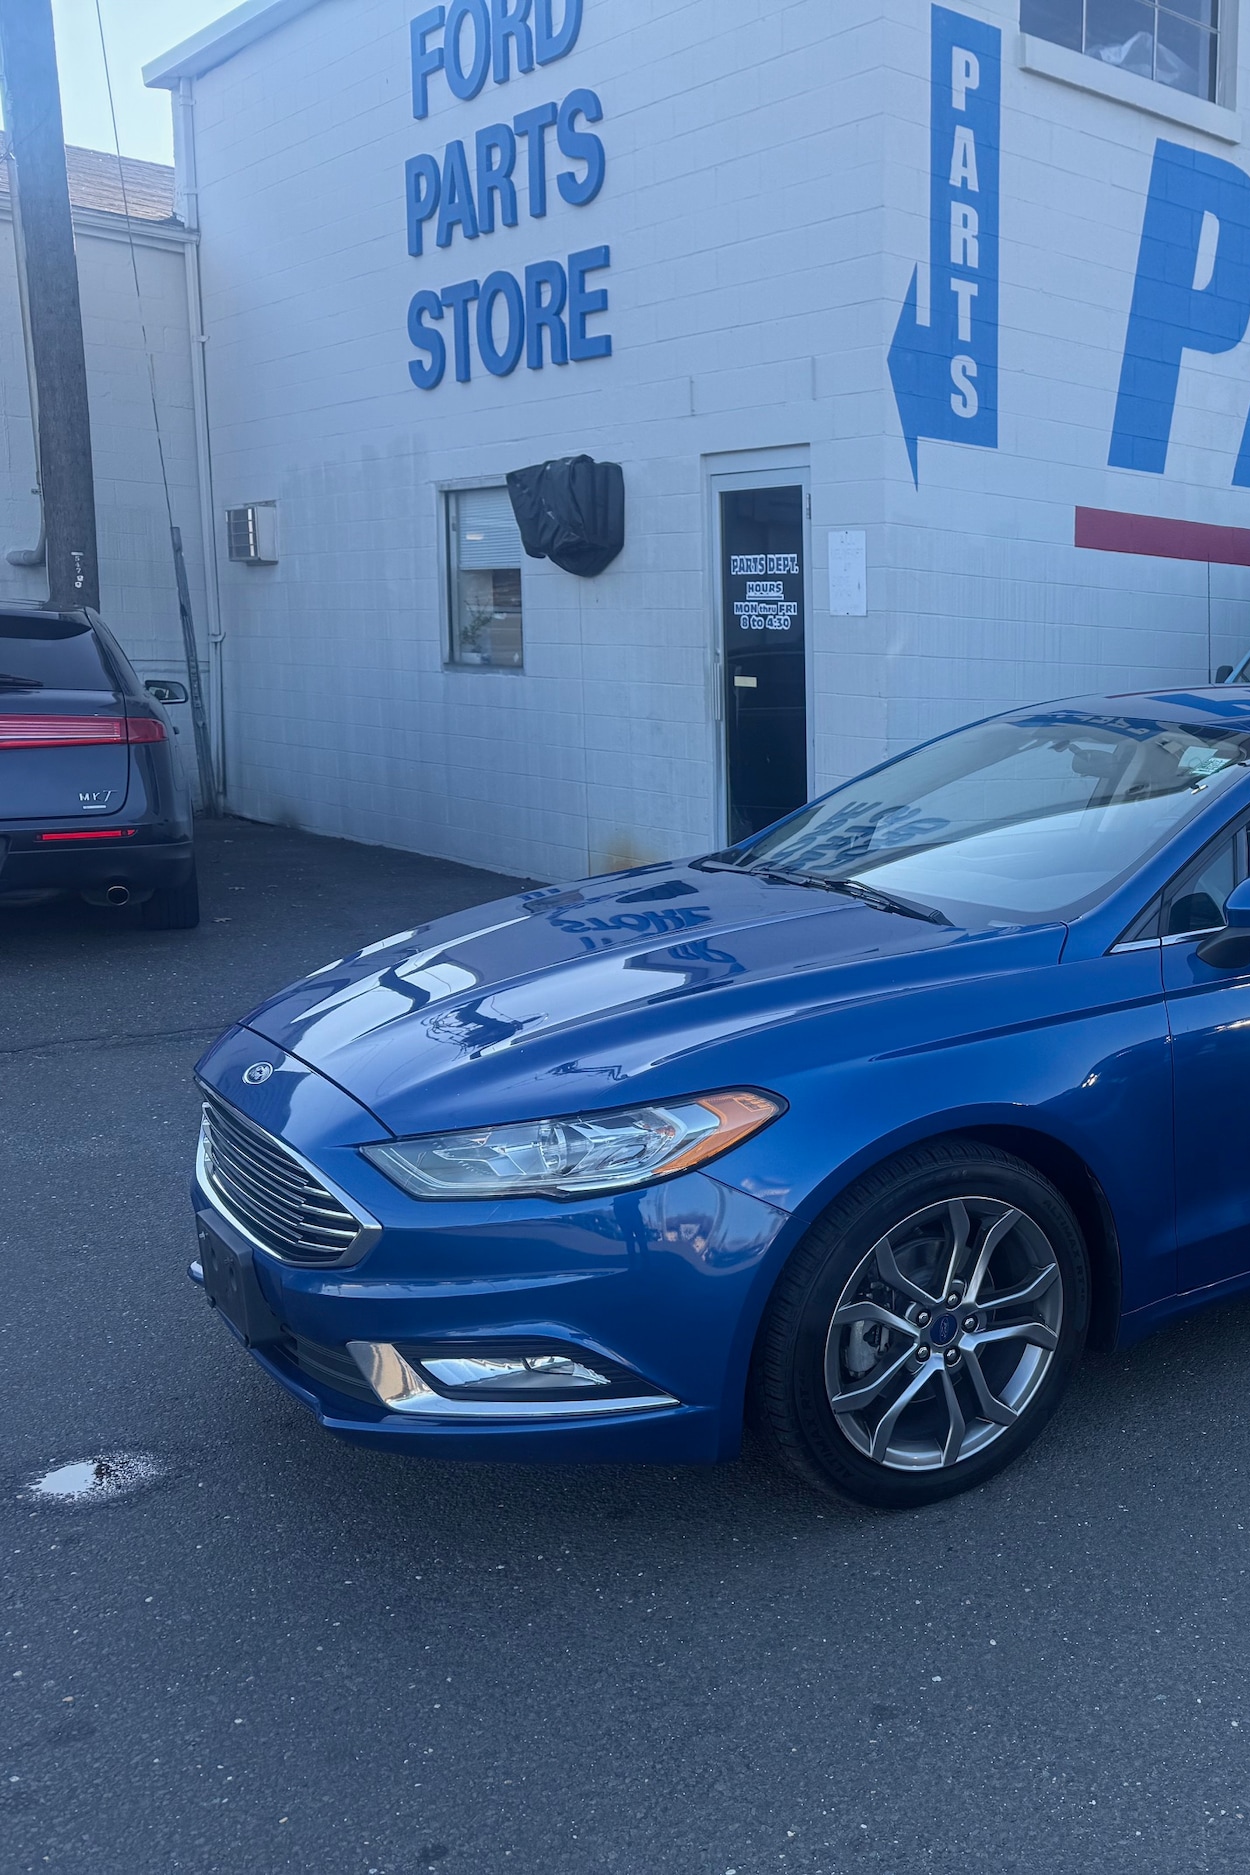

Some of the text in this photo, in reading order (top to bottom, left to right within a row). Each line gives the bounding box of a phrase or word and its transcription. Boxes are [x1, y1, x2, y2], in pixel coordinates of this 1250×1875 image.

[409, 0, 582, 119] FORD
[404, 88, 605, 257] PARTS
[949, 46, 980, 418] PARTS
[407, 245, 612, 390] STORE
[731, 554, 799, 574] PARTS DEPT.
[746, 581, 783, 594] HOURS
[734, 602, 797, 615] MON thru FRI
[740, 615, 791, 629] 8 to 4:30
[79, 789, 119, 803] MKT
